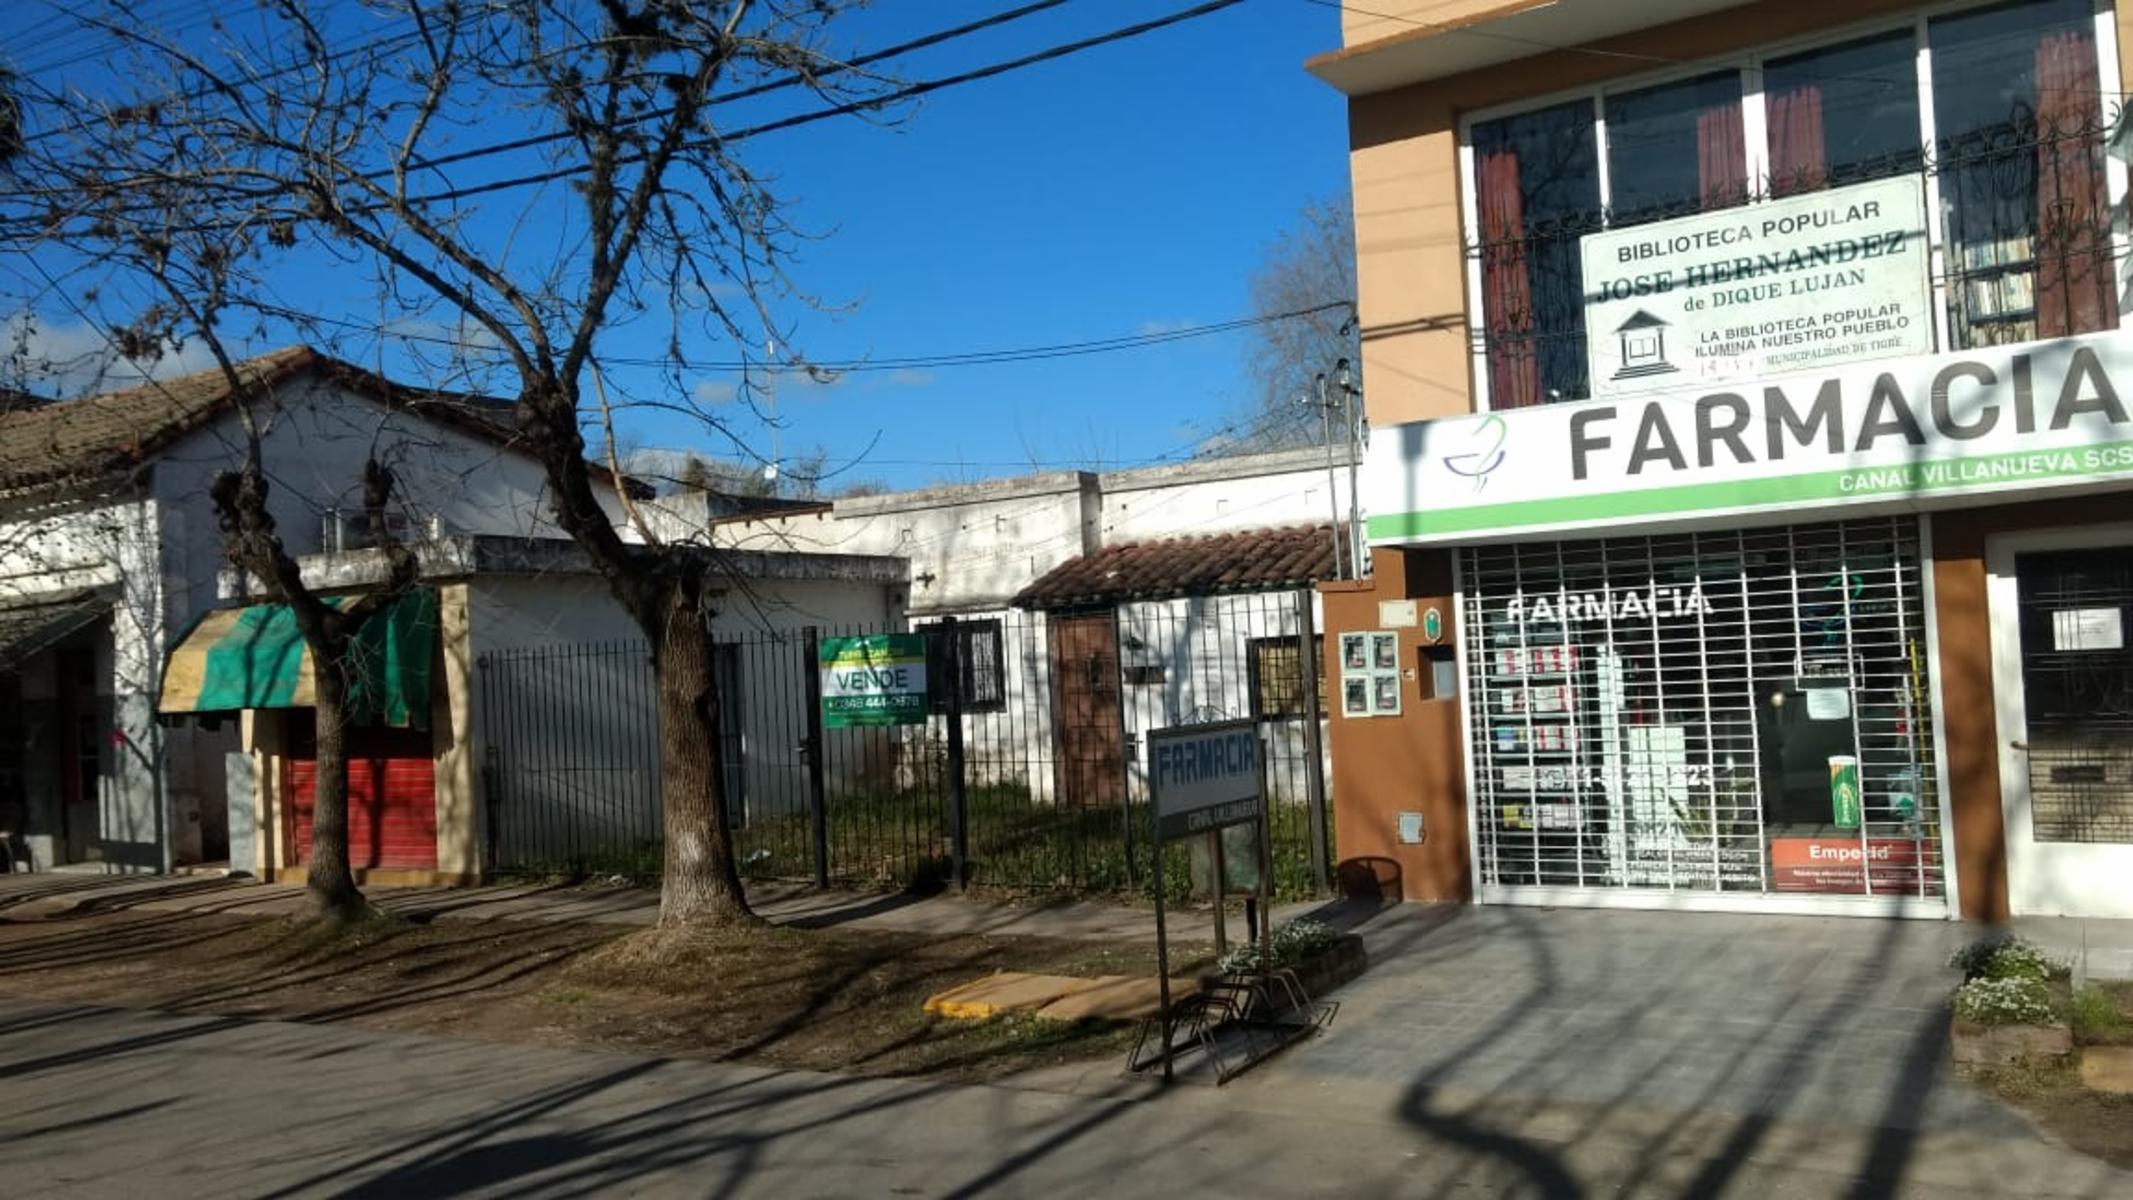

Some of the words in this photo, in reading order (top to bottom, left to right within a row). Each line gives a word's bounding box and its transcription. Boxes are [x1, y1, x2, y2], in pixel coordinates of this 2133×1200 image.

[1618, 224, 1753, 263] BIBLIOTECA
[1762, 201, 1880, 238] POPULAR
[1598, 269, 1674, 303] JOSE
[1685, 229, 1907, 288] HERNANDEZ
[1684, 296, 1705, 312] de
[1713, 283, 1782, 308] DIQUE
[1790, 268, 1867, 295] LUJAN
[1695, 340, 1756, 358] ILUMINA
[1762, 326, 1837, 348] NUESTRO
[1843, 316, 1910, 336] PUEBLO
[1701, 331, 1720, 344] LA
[1725, 317, 1817, 340] BIBLIOTECA
[1823, 303, 1900, 325] POPULAR
[1852, 341, 1867, 353] DE
[1568, 344, 2130, 481] FARMACIA
[1839, 470, 1915, 492] CANAL
[1920, 451, 2078, 483] VILLANUEVA
[1507, 587, 1714, 624] FARMACIA
[836, 668, 909, 690] VENDE
[1158, 732, 1256, 791] FARMACIA
